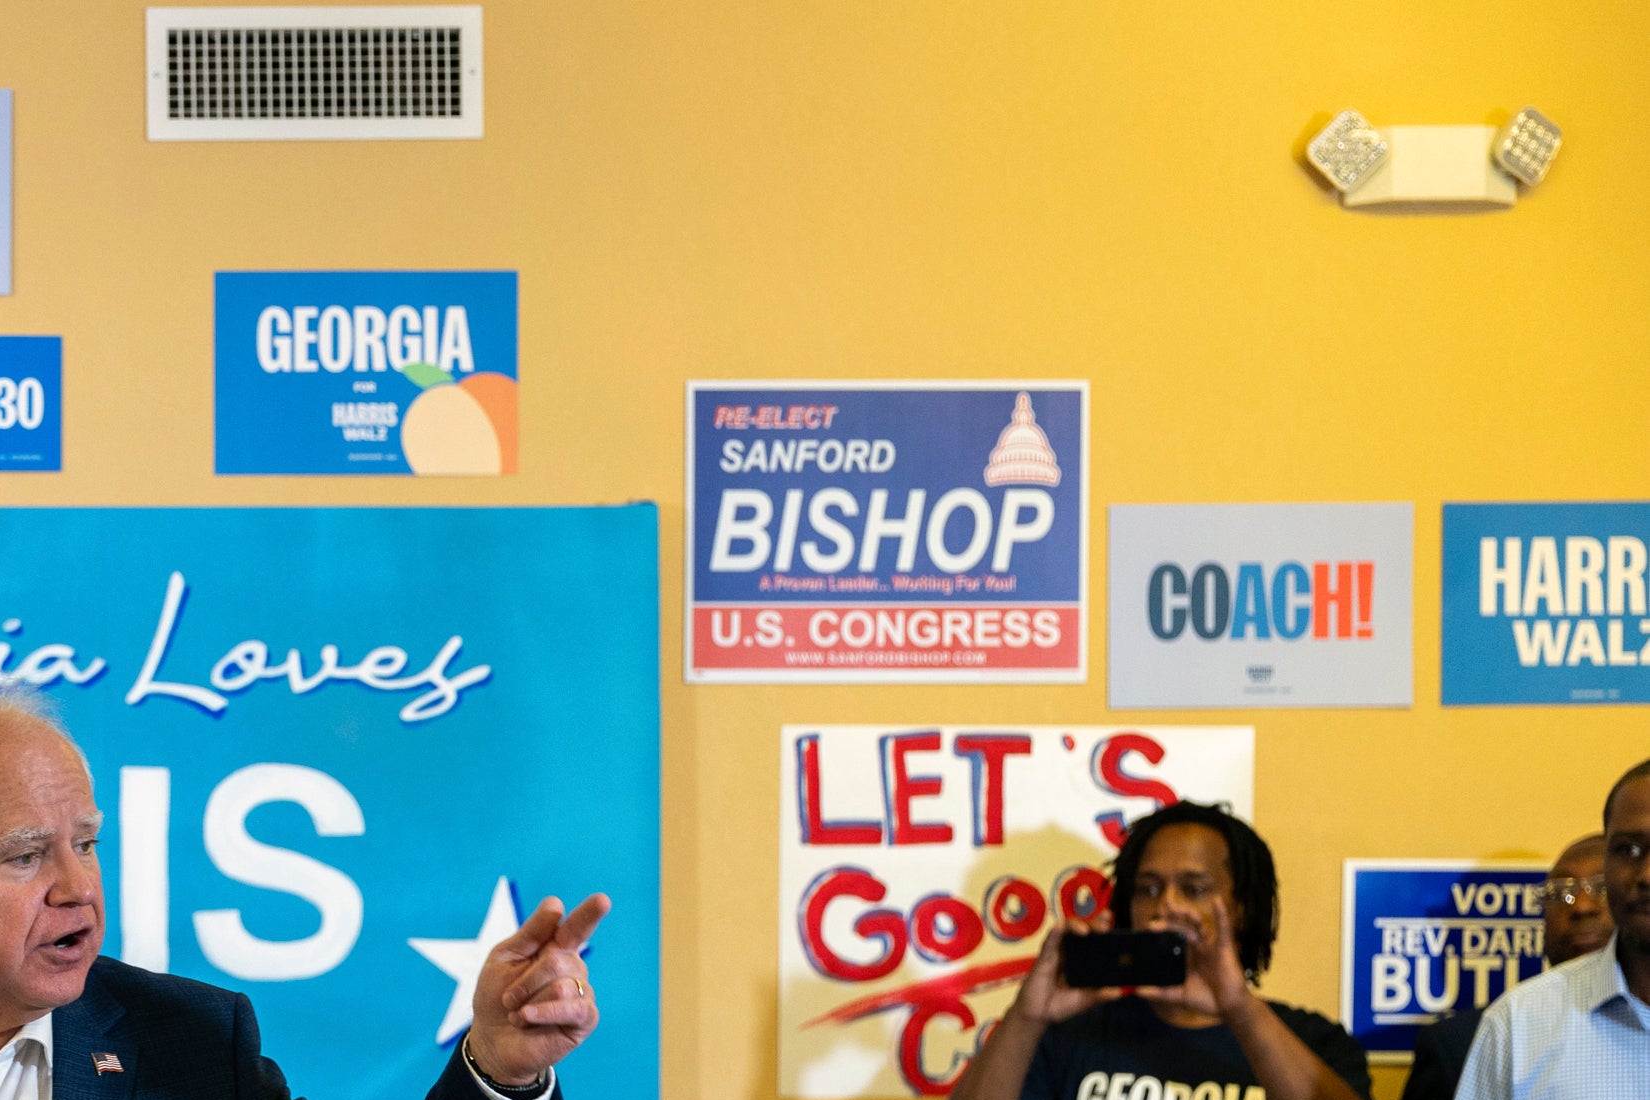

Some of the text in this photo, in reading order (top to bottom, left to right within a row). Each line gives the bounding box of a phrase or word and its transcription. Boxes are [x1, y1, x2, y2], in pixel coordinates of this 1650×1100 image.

[256, 305, 475, 373] GEORGIA
[331, 402, 398, 427] HARRIS
[343, 427, 388, 442] WALZ
[714, 406, 839, 430] RE-ELECT
[720, 439, 896, 473] SANFORD
[709, 487, 1055, 573] BISHOP
[1148, 560, 1375, 641] COACH!
[1479, 535, 1650, 617] HARR
[125, 571, 492, 724] Loves
[710, 610, 1062, 648] U.S. CONGRESS
[794, 730, 1180, 848] LET'S
[1381, 925, 1456, 957] REV.
